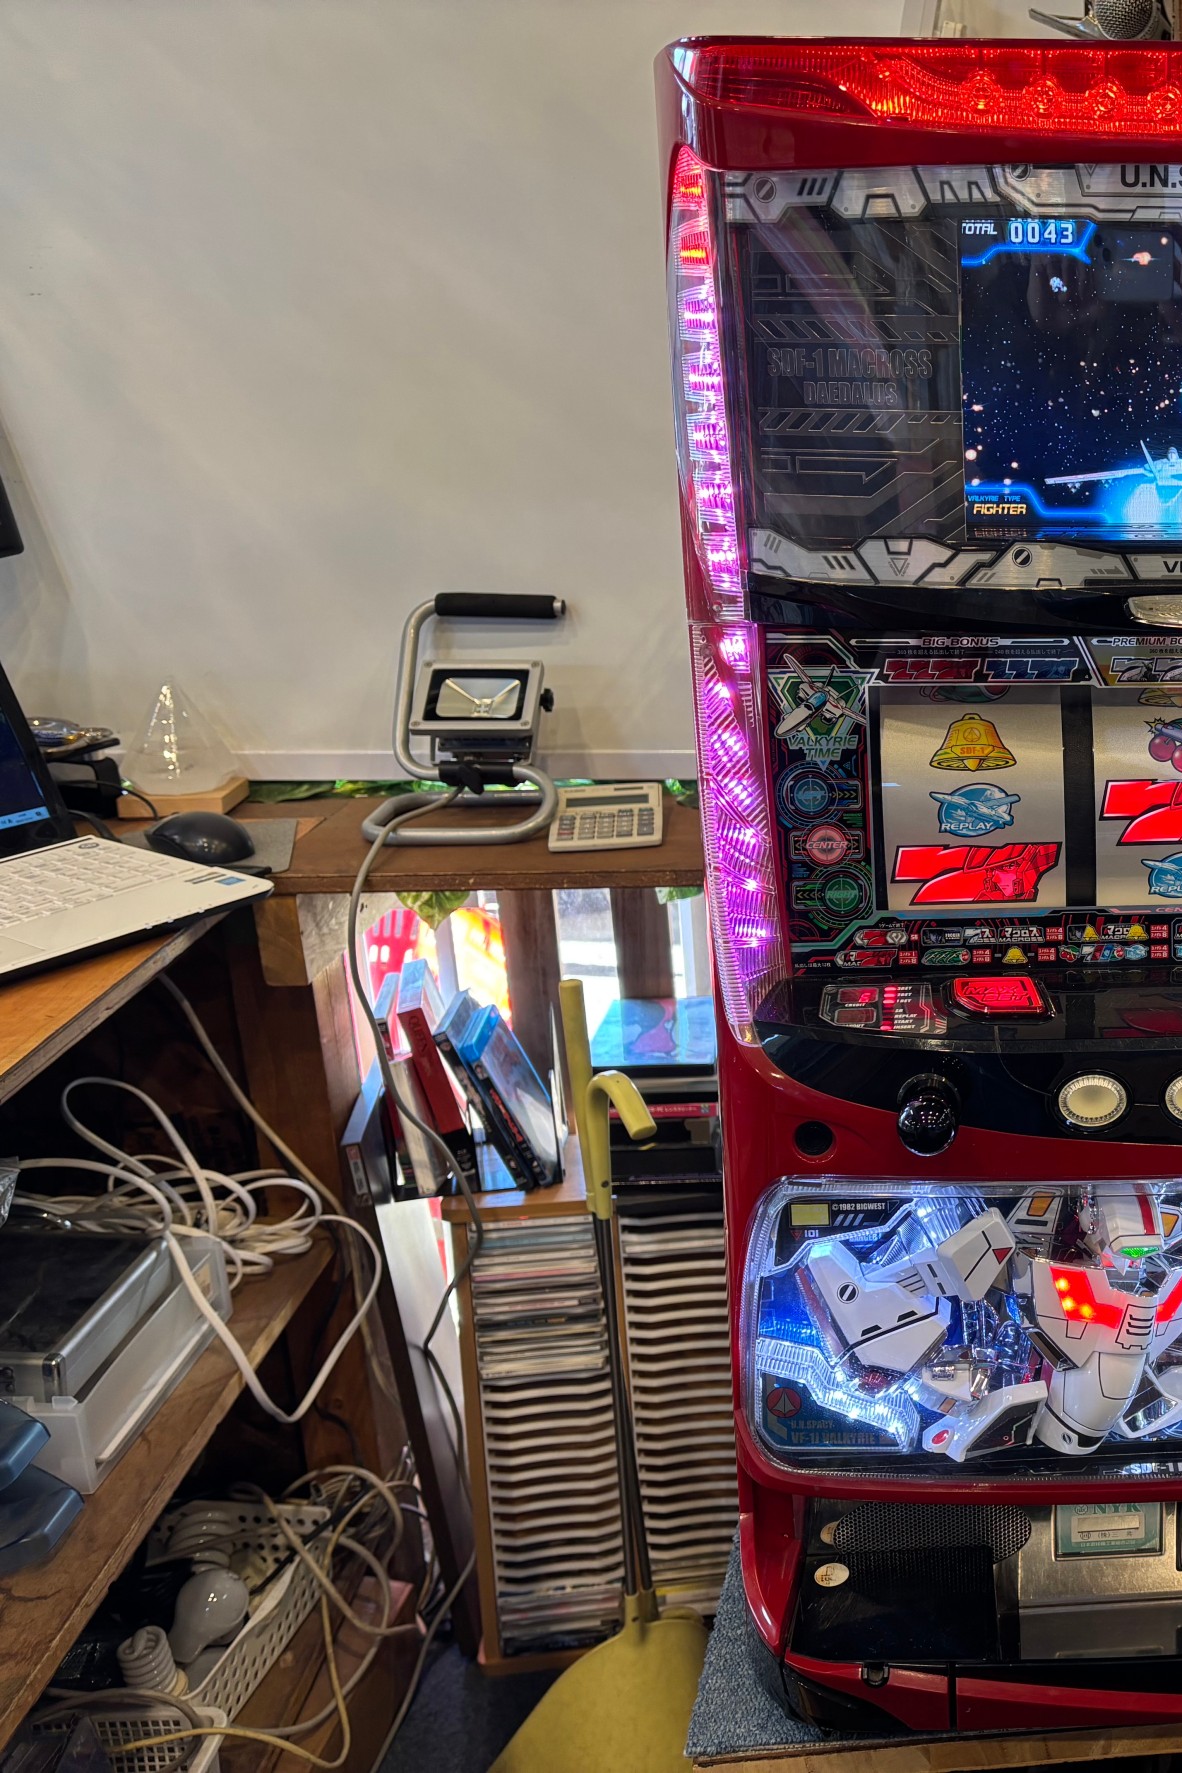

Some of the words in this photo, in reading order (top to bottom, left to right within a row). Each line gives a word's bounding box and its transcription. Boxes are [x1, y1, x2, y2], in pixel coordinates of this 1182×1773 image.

[1009, 222, 1073, 243] 0043
[766, 348, 825, 378] SDF-1
[827, 348, 934, 379] MACROSS
[803, 381, 899, 406] DAEDALUS
[973, 503, 1027, 515] FIGHTER
[922, 638, 947, 647] BIG
[949, 637, 1000, 647] BONUS
[1112, 636, 1165, 647] PREMIUM
[787, 735, 858, 749] VALKYRIE
[804, 748, 841, 761] TIME
[941, 821, 994, 832] REPLAY
[806, 841, 849, 850] CENTER
